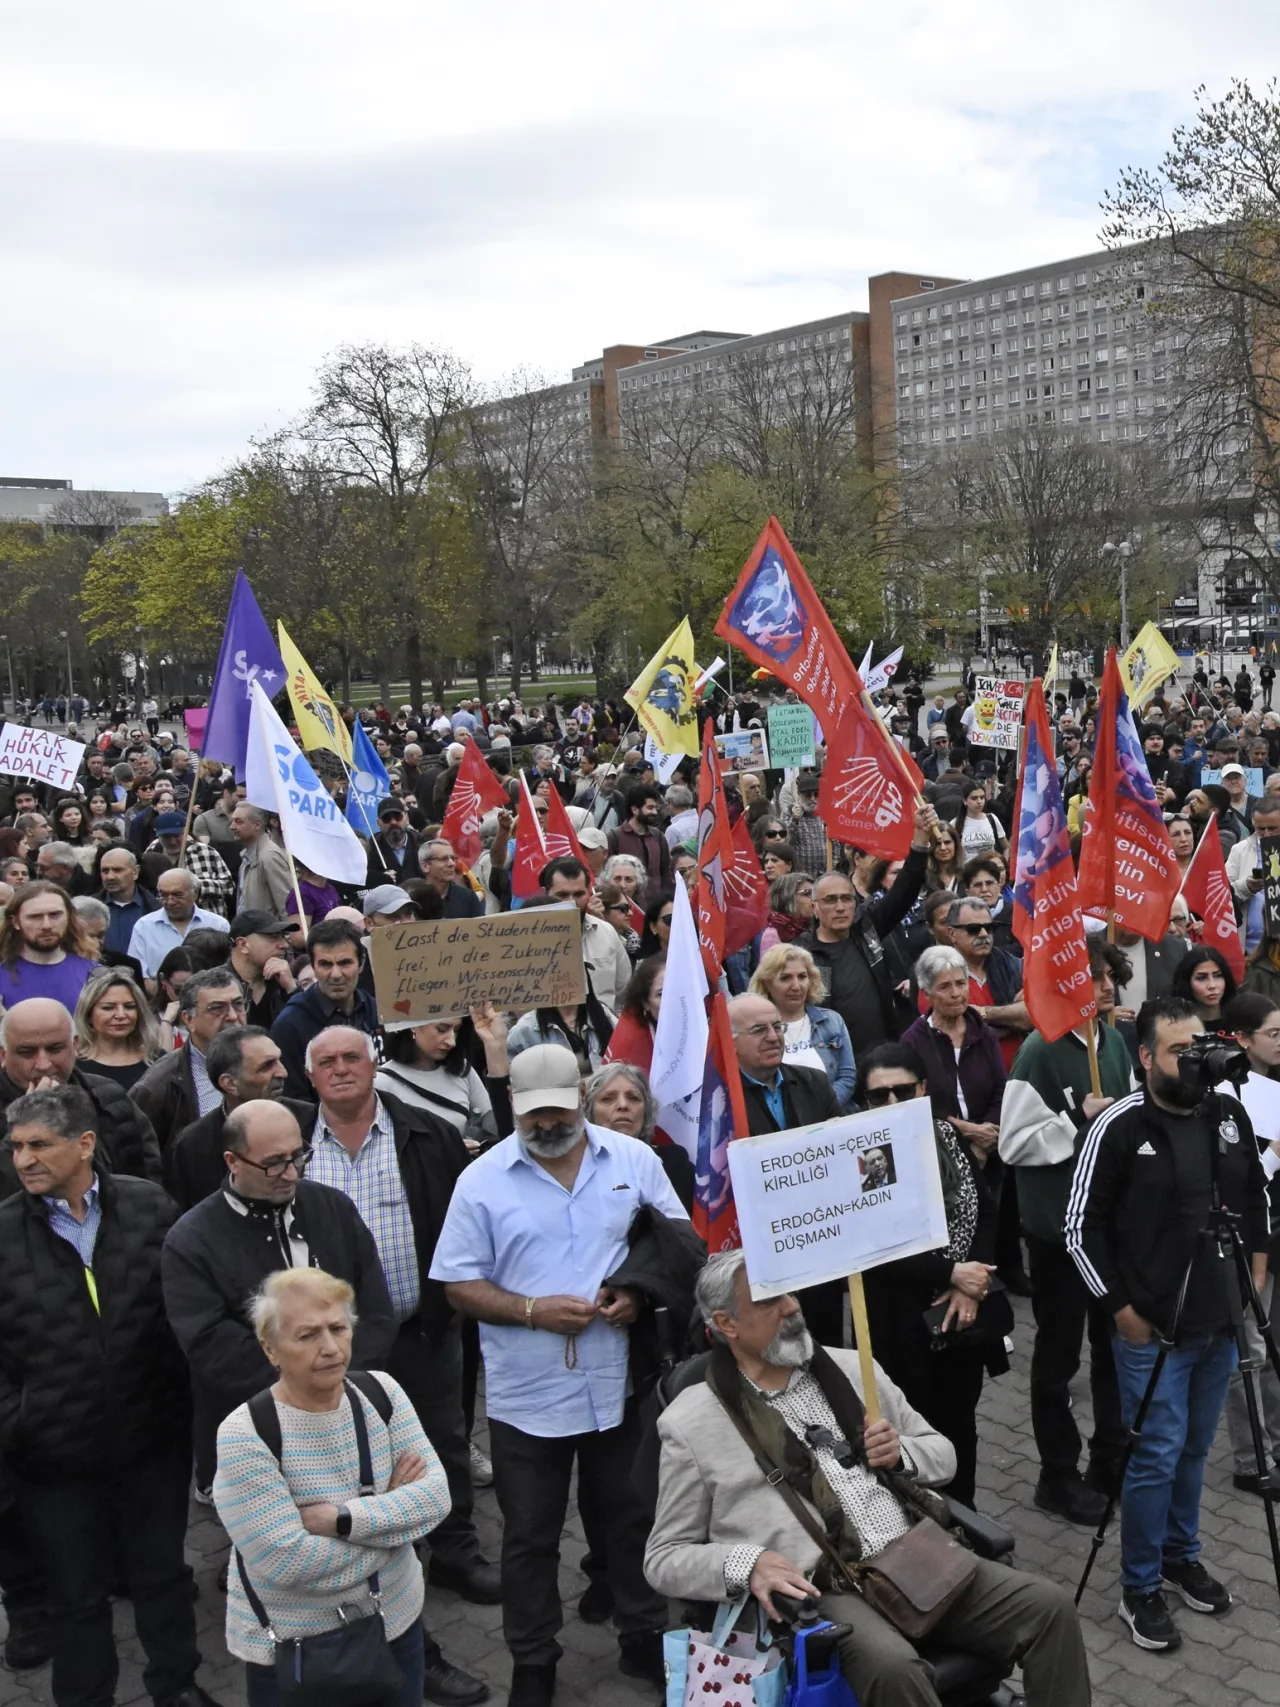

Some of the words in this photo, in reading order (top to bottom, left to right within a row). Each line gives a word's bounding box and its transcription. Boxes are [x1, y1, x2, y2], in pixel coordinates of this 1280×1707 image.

[4, 739, 68, 763] HUKUK
[21, 729, 66, 750] HAK
[0, 756, 74, 785] ADALET
[447, 925, 470, 943] die
[476, 918, 571, 940] StudentInnen
[395, 957, 429, 976] frei,
[438, 951, 454, 967] in
[462, 946, 490, 964] die
[500, 938, 573, 960] Zukunft
[761, 1143, 835, 1173] ERDOĞAN
[764, 1163, 829, 1193] KİRLİLİĞİ
[771, 1189, 893, 1235] ERDOĞAN=KADIN
[774, 1224, 841, 1254] DÜŞMANI
